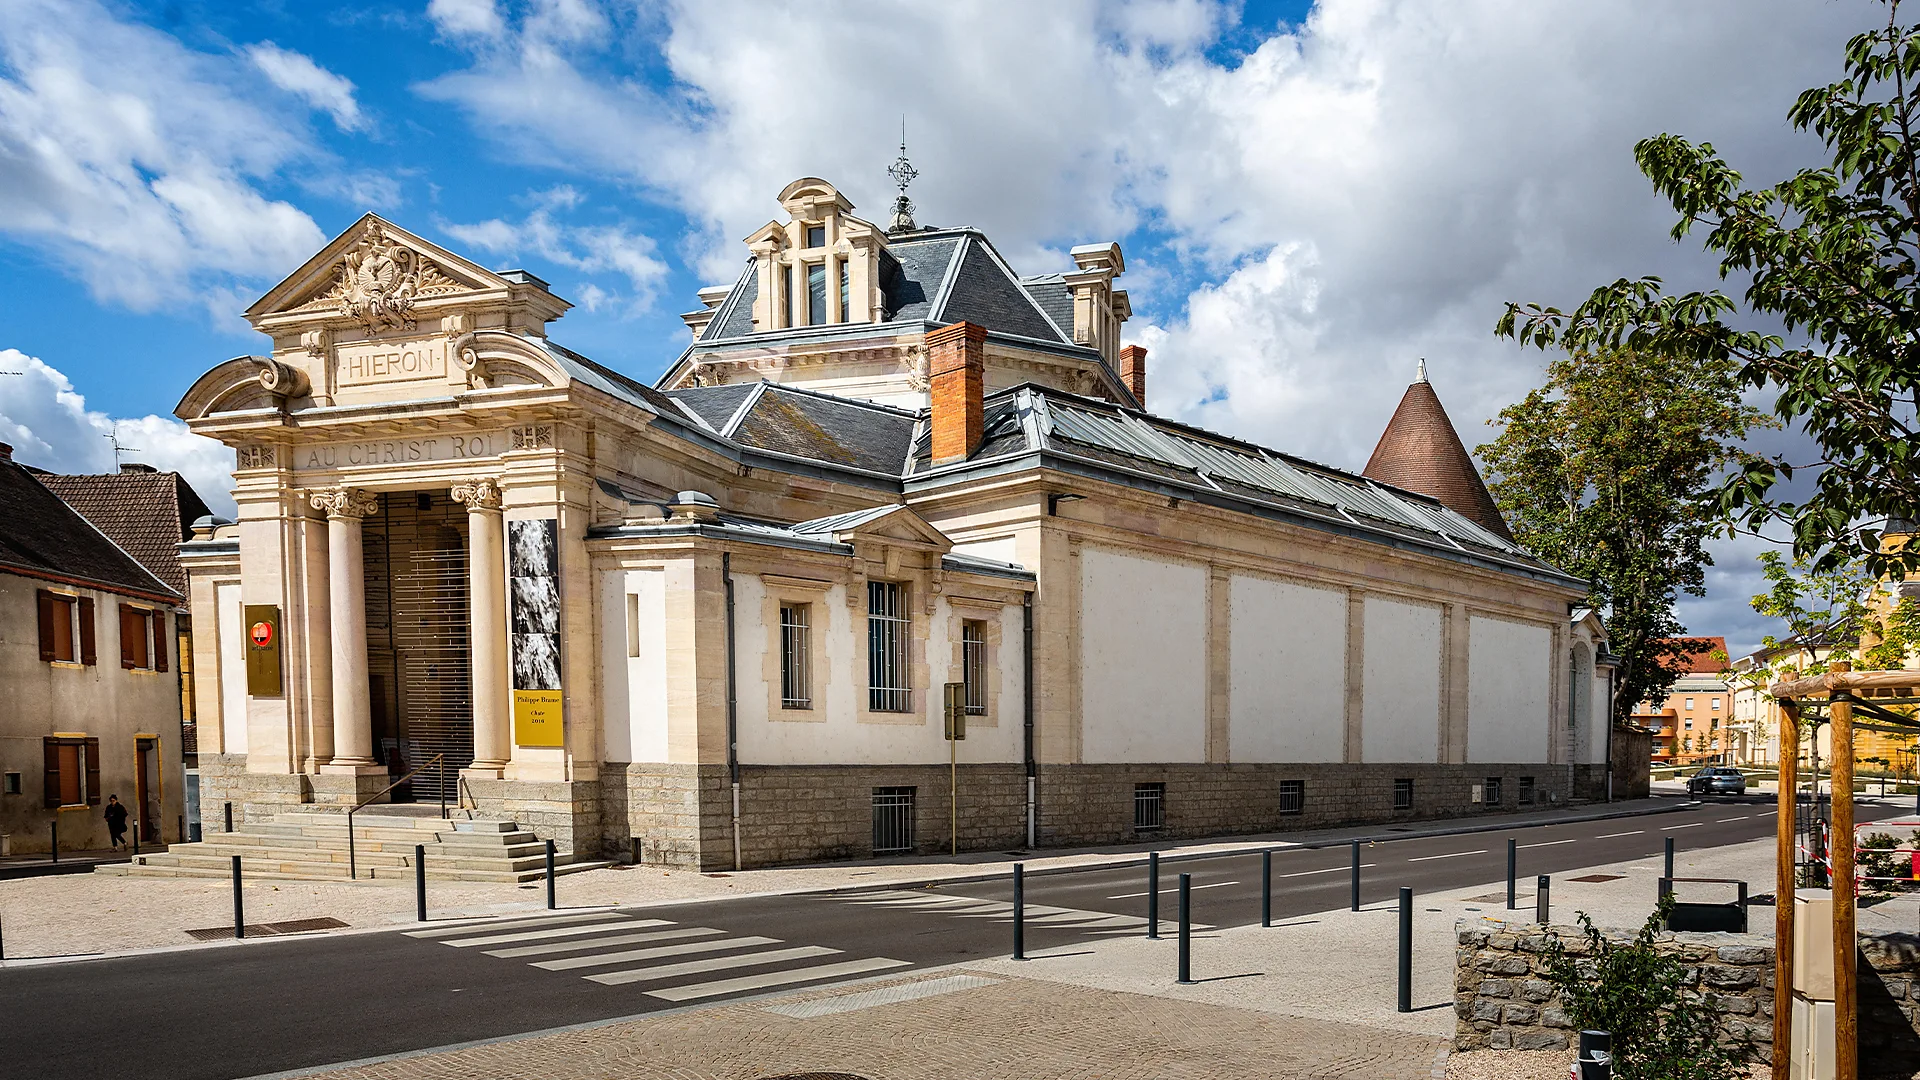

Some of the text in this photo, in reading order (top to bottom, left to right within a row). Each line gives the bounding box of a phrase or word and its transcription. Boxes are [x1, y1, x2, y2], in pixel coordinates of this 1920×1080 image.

[348, 348, 434, 379] HIERON
[306, 434, 494, 468] AU CHRIST ROI
[517, 696, 540, 704] Philippe
